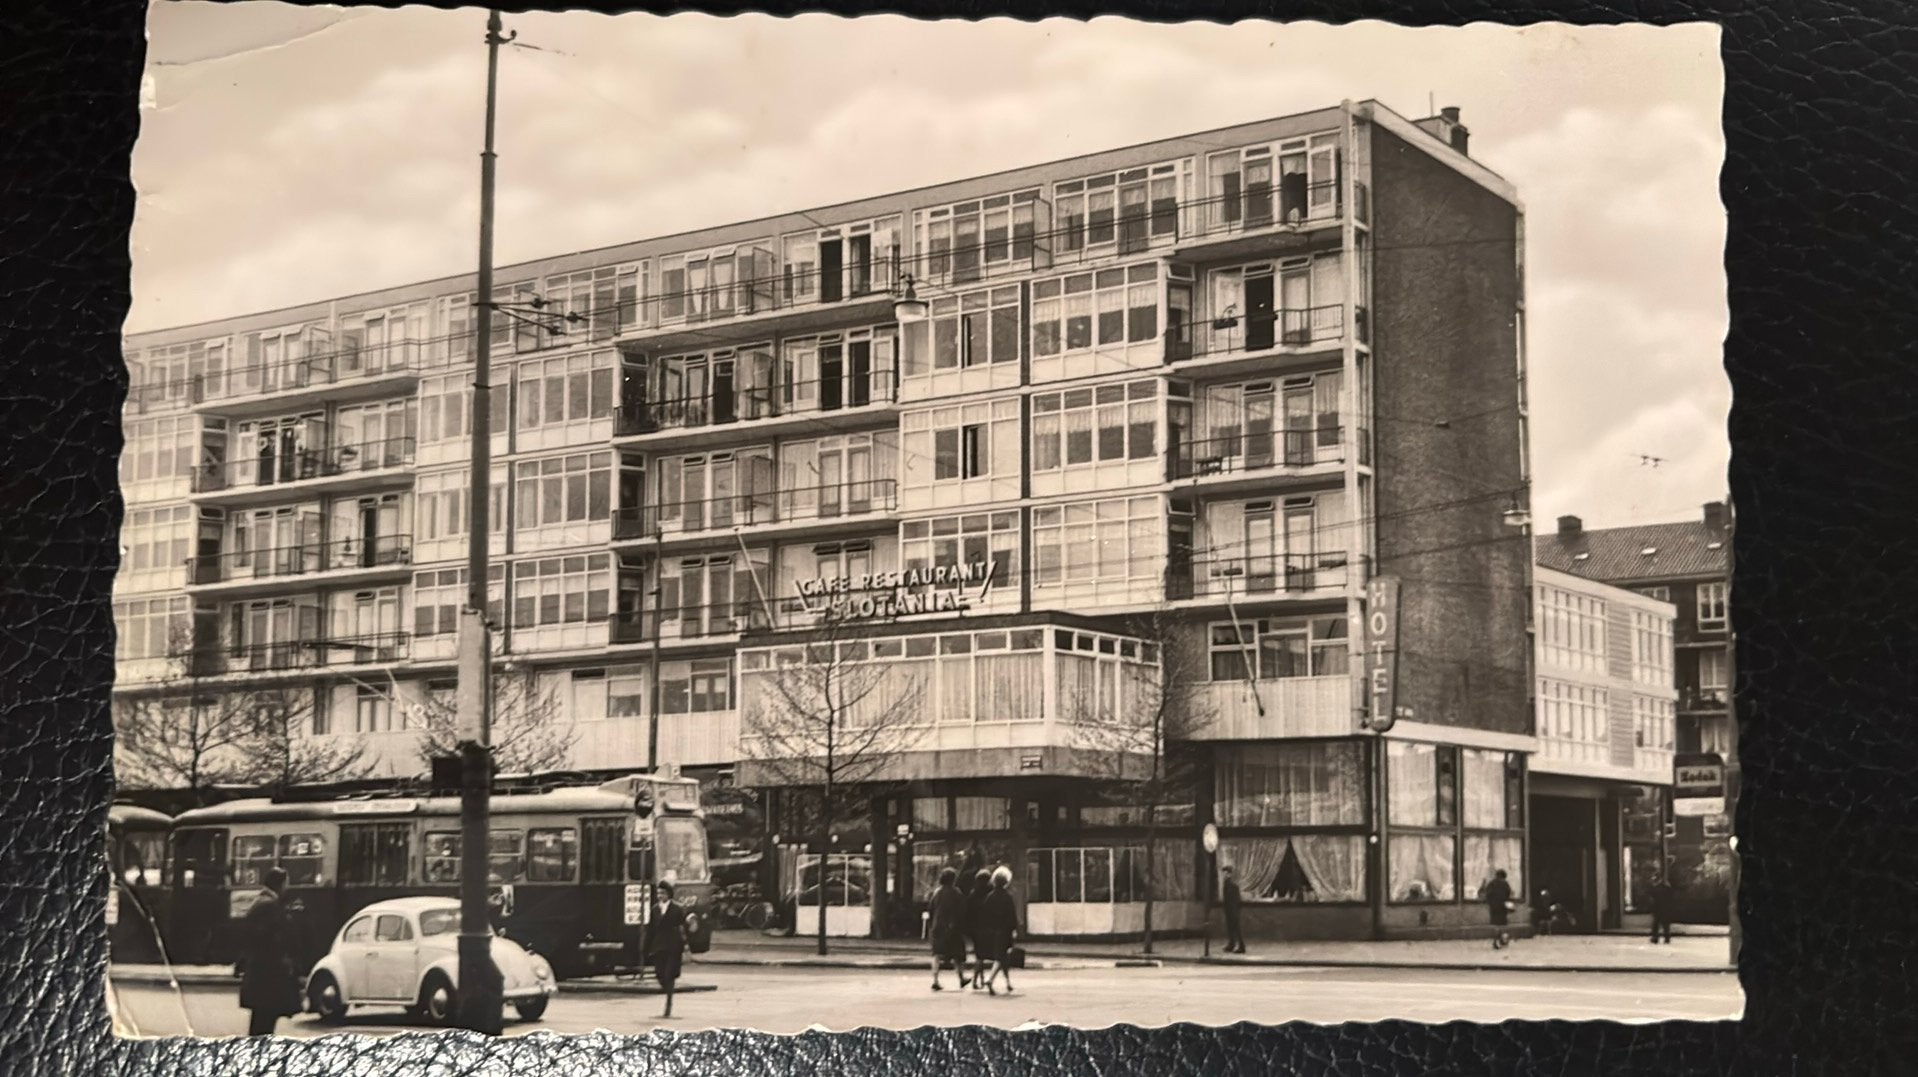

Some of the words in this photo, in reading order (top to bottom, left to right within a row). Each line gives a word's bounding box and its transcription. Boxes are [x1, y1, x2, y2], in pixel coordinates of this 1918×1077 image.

[861, 562, 987, 590] RESTAURANT
[831, 593, 958, 620] SLOTANIA
[1370, 582, 1388, 722] HOTEL
